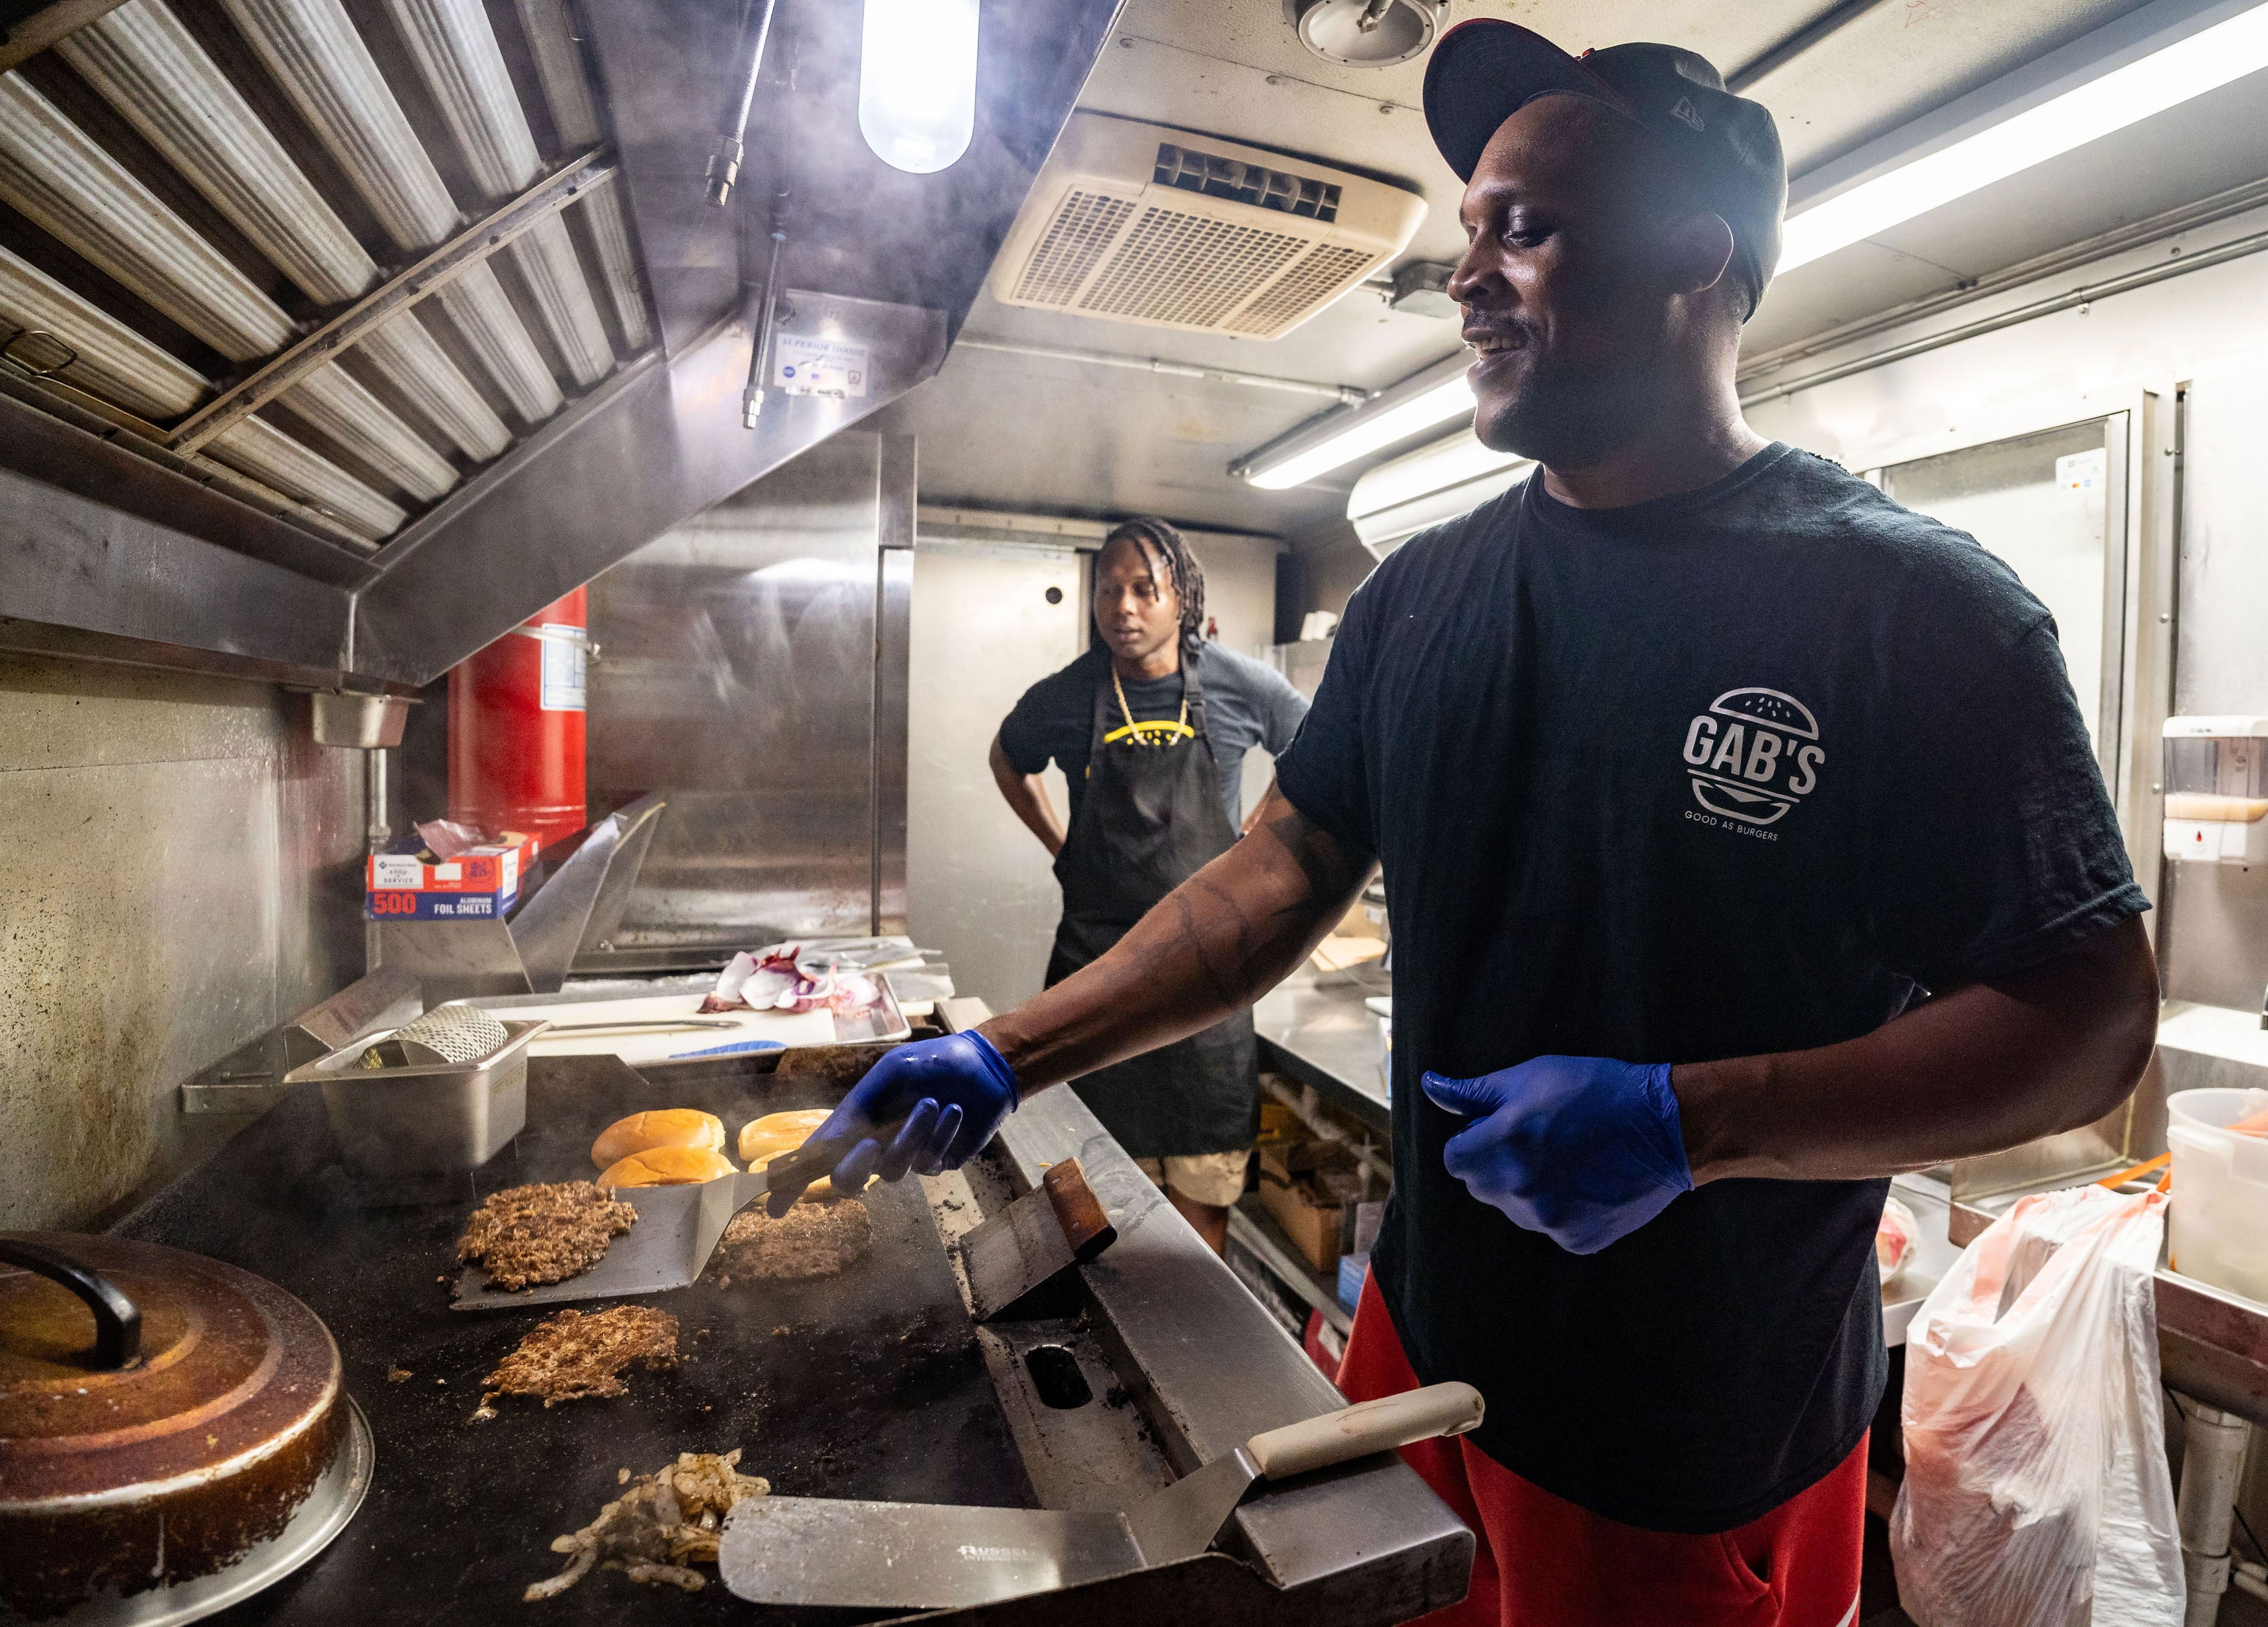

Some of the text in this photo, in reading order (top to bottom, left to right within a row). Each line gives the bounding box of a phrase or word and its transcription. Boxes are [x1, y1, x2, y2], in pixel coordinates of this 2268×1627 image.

[1683, 715, 1826, 795] GAB'S
[1685, 811, 1778, 842] GOOD AS BURGERS
[373, 894, 416, 914] 500
[434, 904, 454, 915] FOIL
[457, 904, 492, 914] SHEETS
